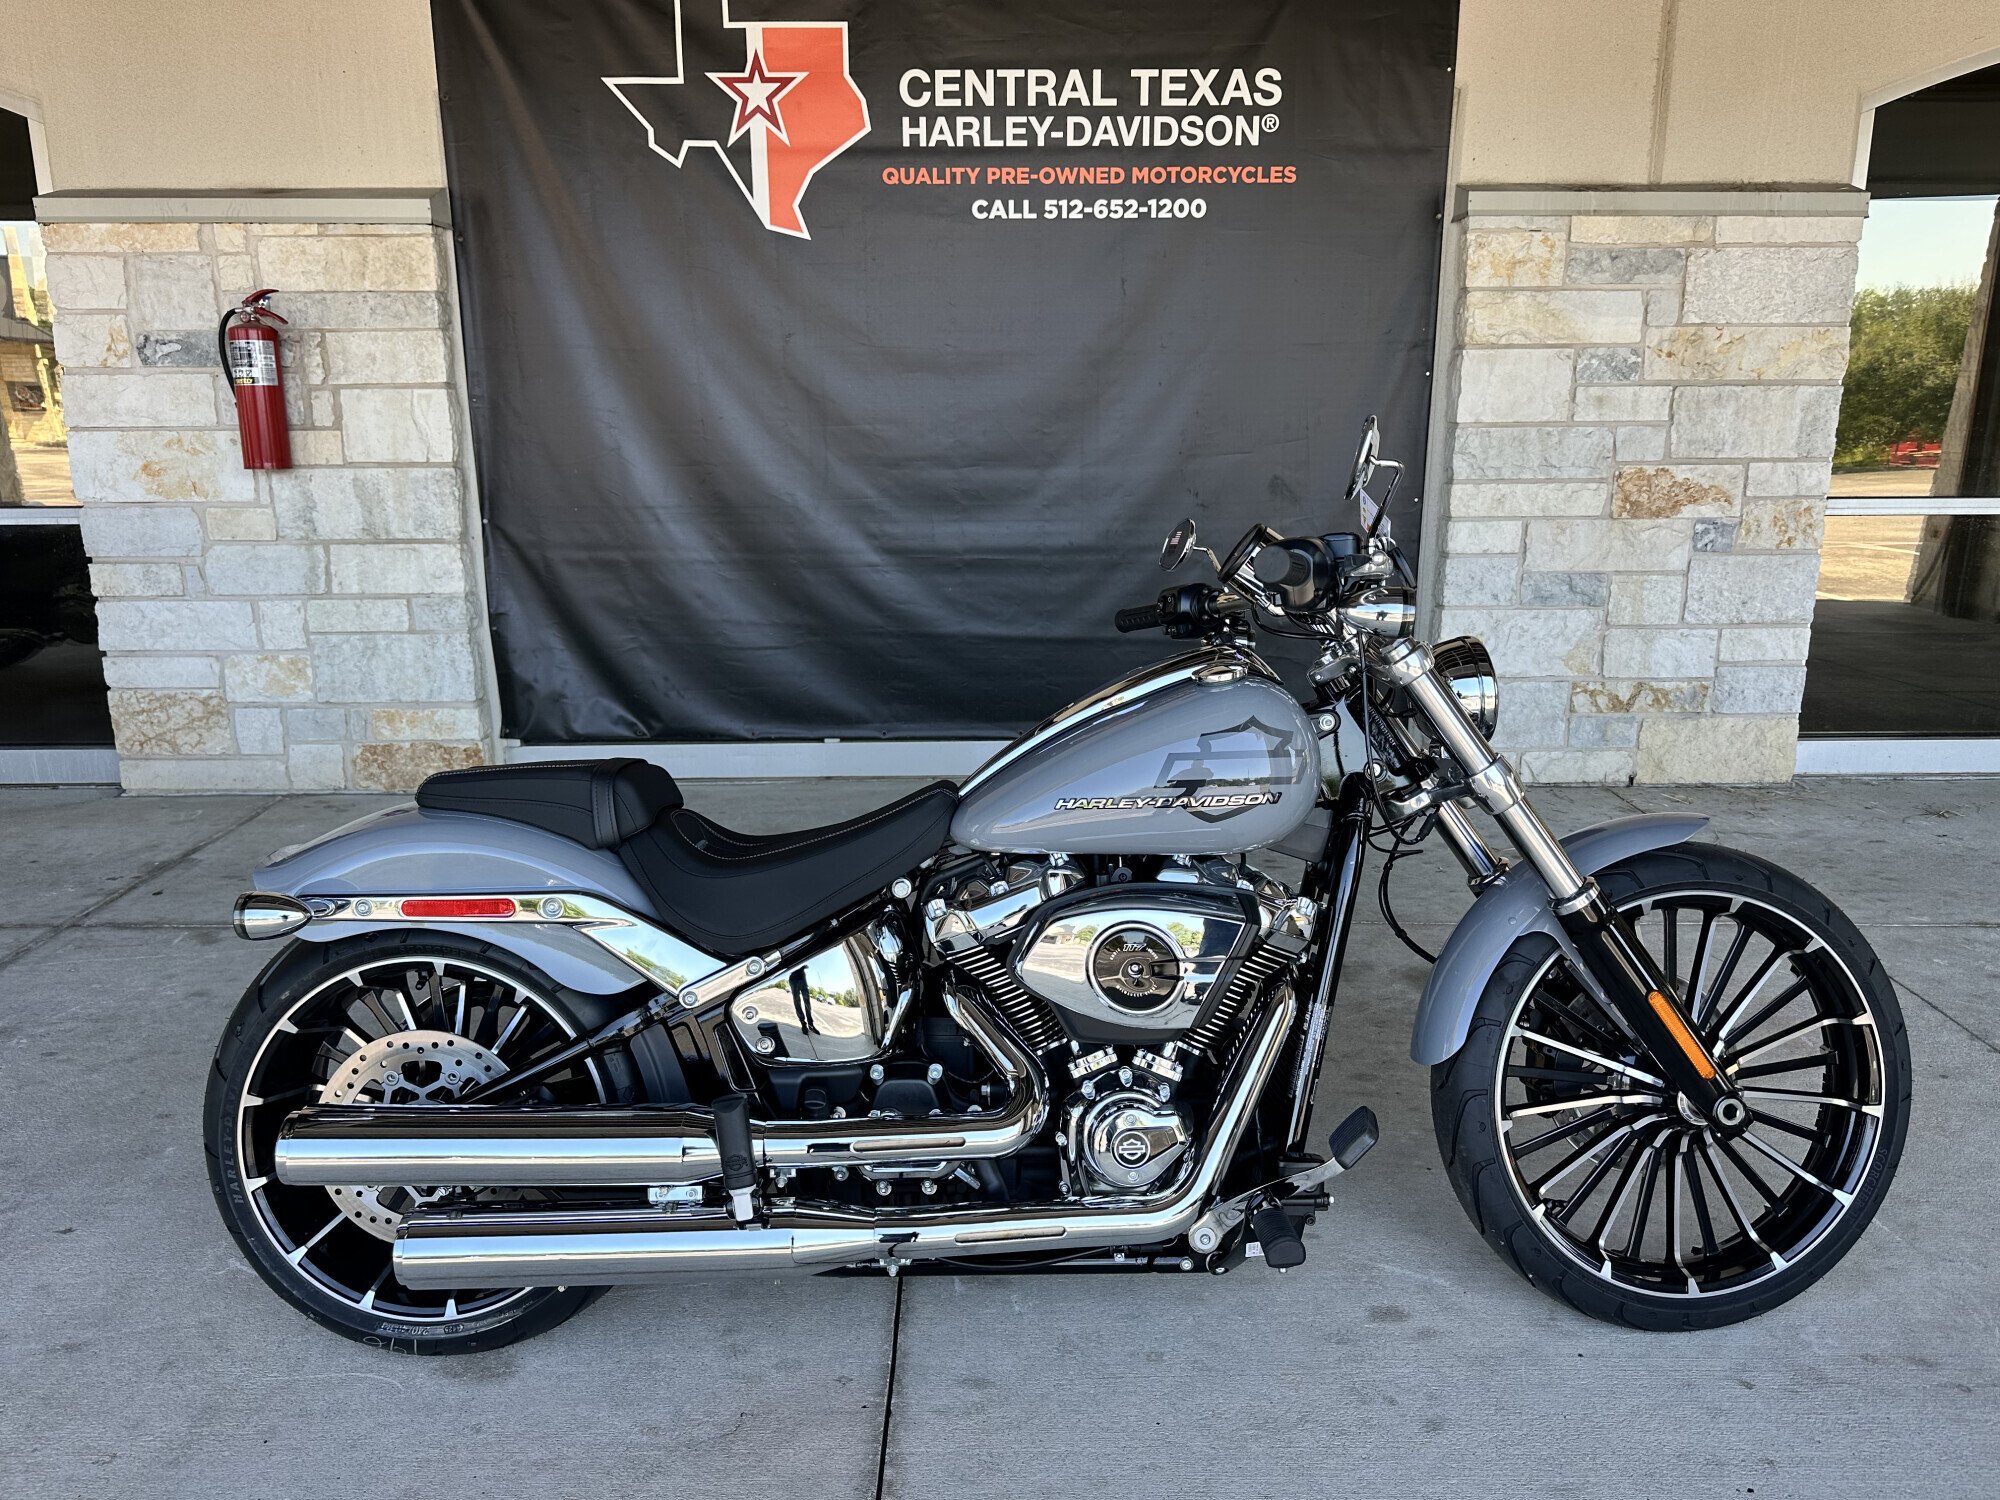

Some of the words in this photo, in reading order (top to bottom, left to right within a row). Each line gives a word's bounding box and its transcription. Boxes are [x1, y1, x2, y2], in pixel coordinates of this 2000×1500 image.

[900, 68, 1118, 108] CENTRAL
[1130, 67, 1283, 107] TEXAS
[881, 167, 981, 185] QUALITY
[986, 166, 1126, 185] PRE-OWNED
[1131, 165, 1297, 185] MOTORCYCLES
[971, 198, 1038, 220] CALL
[1043, 198, 1207, 220] 512-652-1200
[1054, 791, 1283, 812] HARLEY-DAVIDSON
